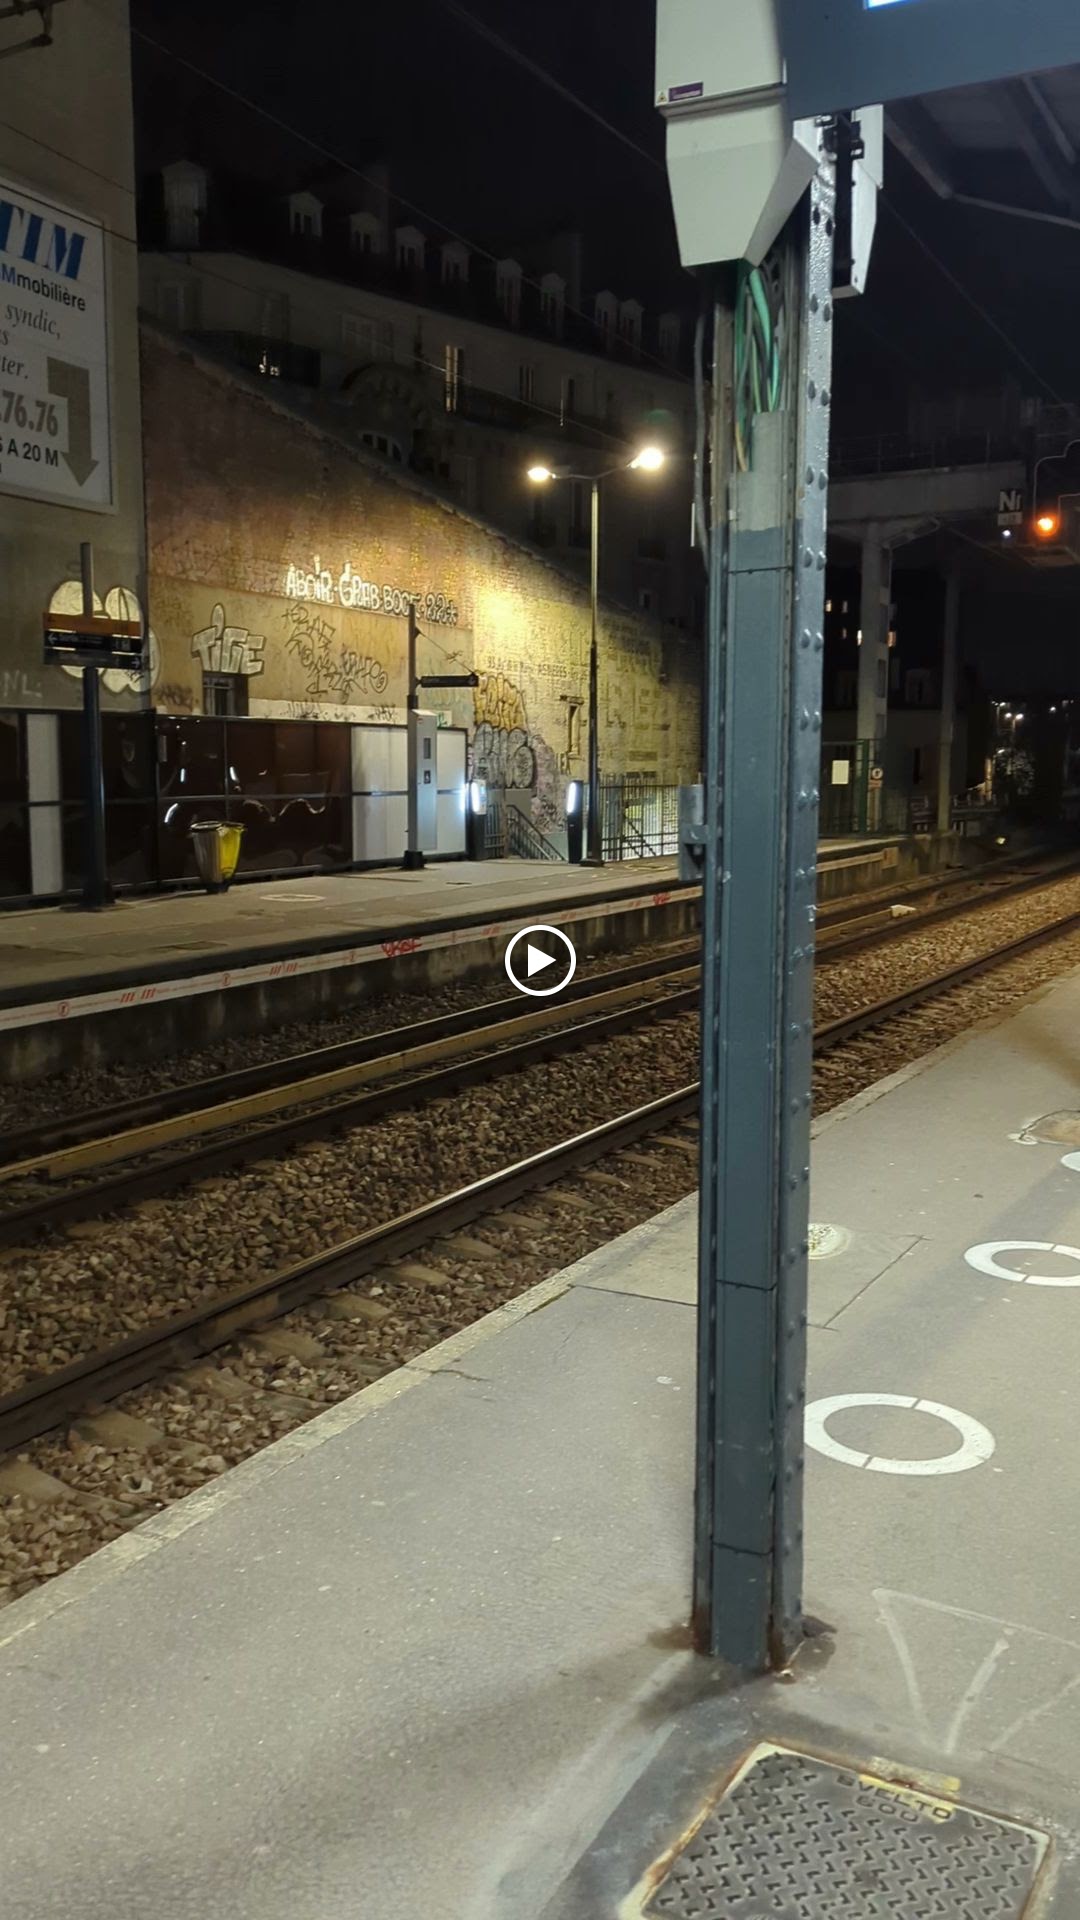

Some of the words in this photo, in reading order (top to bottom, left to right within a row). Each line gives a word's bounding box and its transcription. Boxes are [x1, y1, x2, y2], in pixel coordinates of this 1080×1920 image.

[5, 304, 61, 340] syndic,
[7, 438, 19, 457] A
[22, 442, 41, 462] 20
[45, 447, 58, 468] M
